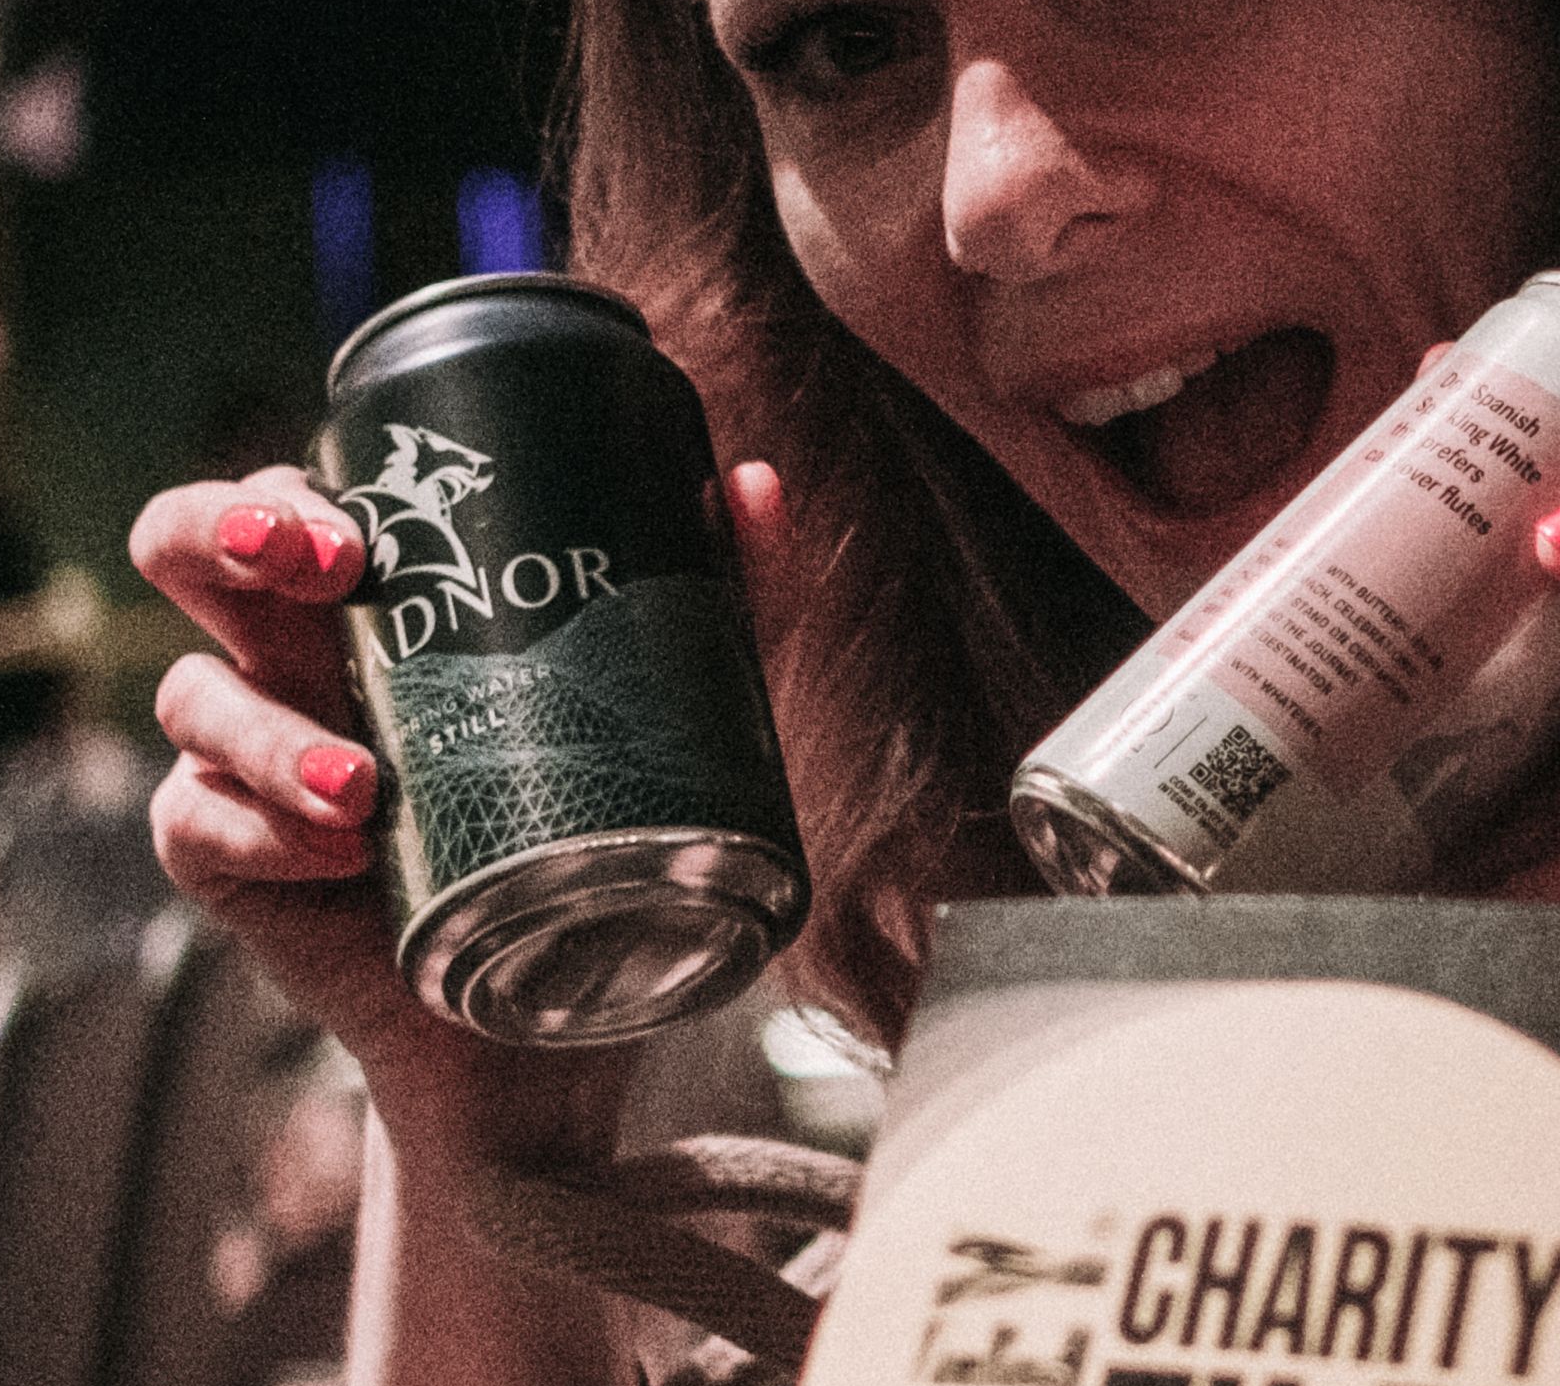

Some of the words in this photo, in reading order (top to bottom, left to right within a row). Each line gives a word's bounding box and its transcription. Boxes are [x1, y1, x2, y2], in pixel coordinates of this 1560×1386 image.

[1469, 383, 1539, 439] Spanish
[1414, 396, 1490, 447] Spkling
[1487, 432, 1544, 487] White
[1418, 434, 1487, 485] prefers
[1396, 463, 1441, 495] over
[1437, 484, 1493, 537] flutes
[1325, 562, 1358, 591] WITH
[347, 547, 619, 699] ADNOR
[1282, 618, 1307, 641] THE
[1289, 596, 1330, 629] STAND
[466, 665, 554, 705] WATER
[429, 709, 506, 755] STILL
